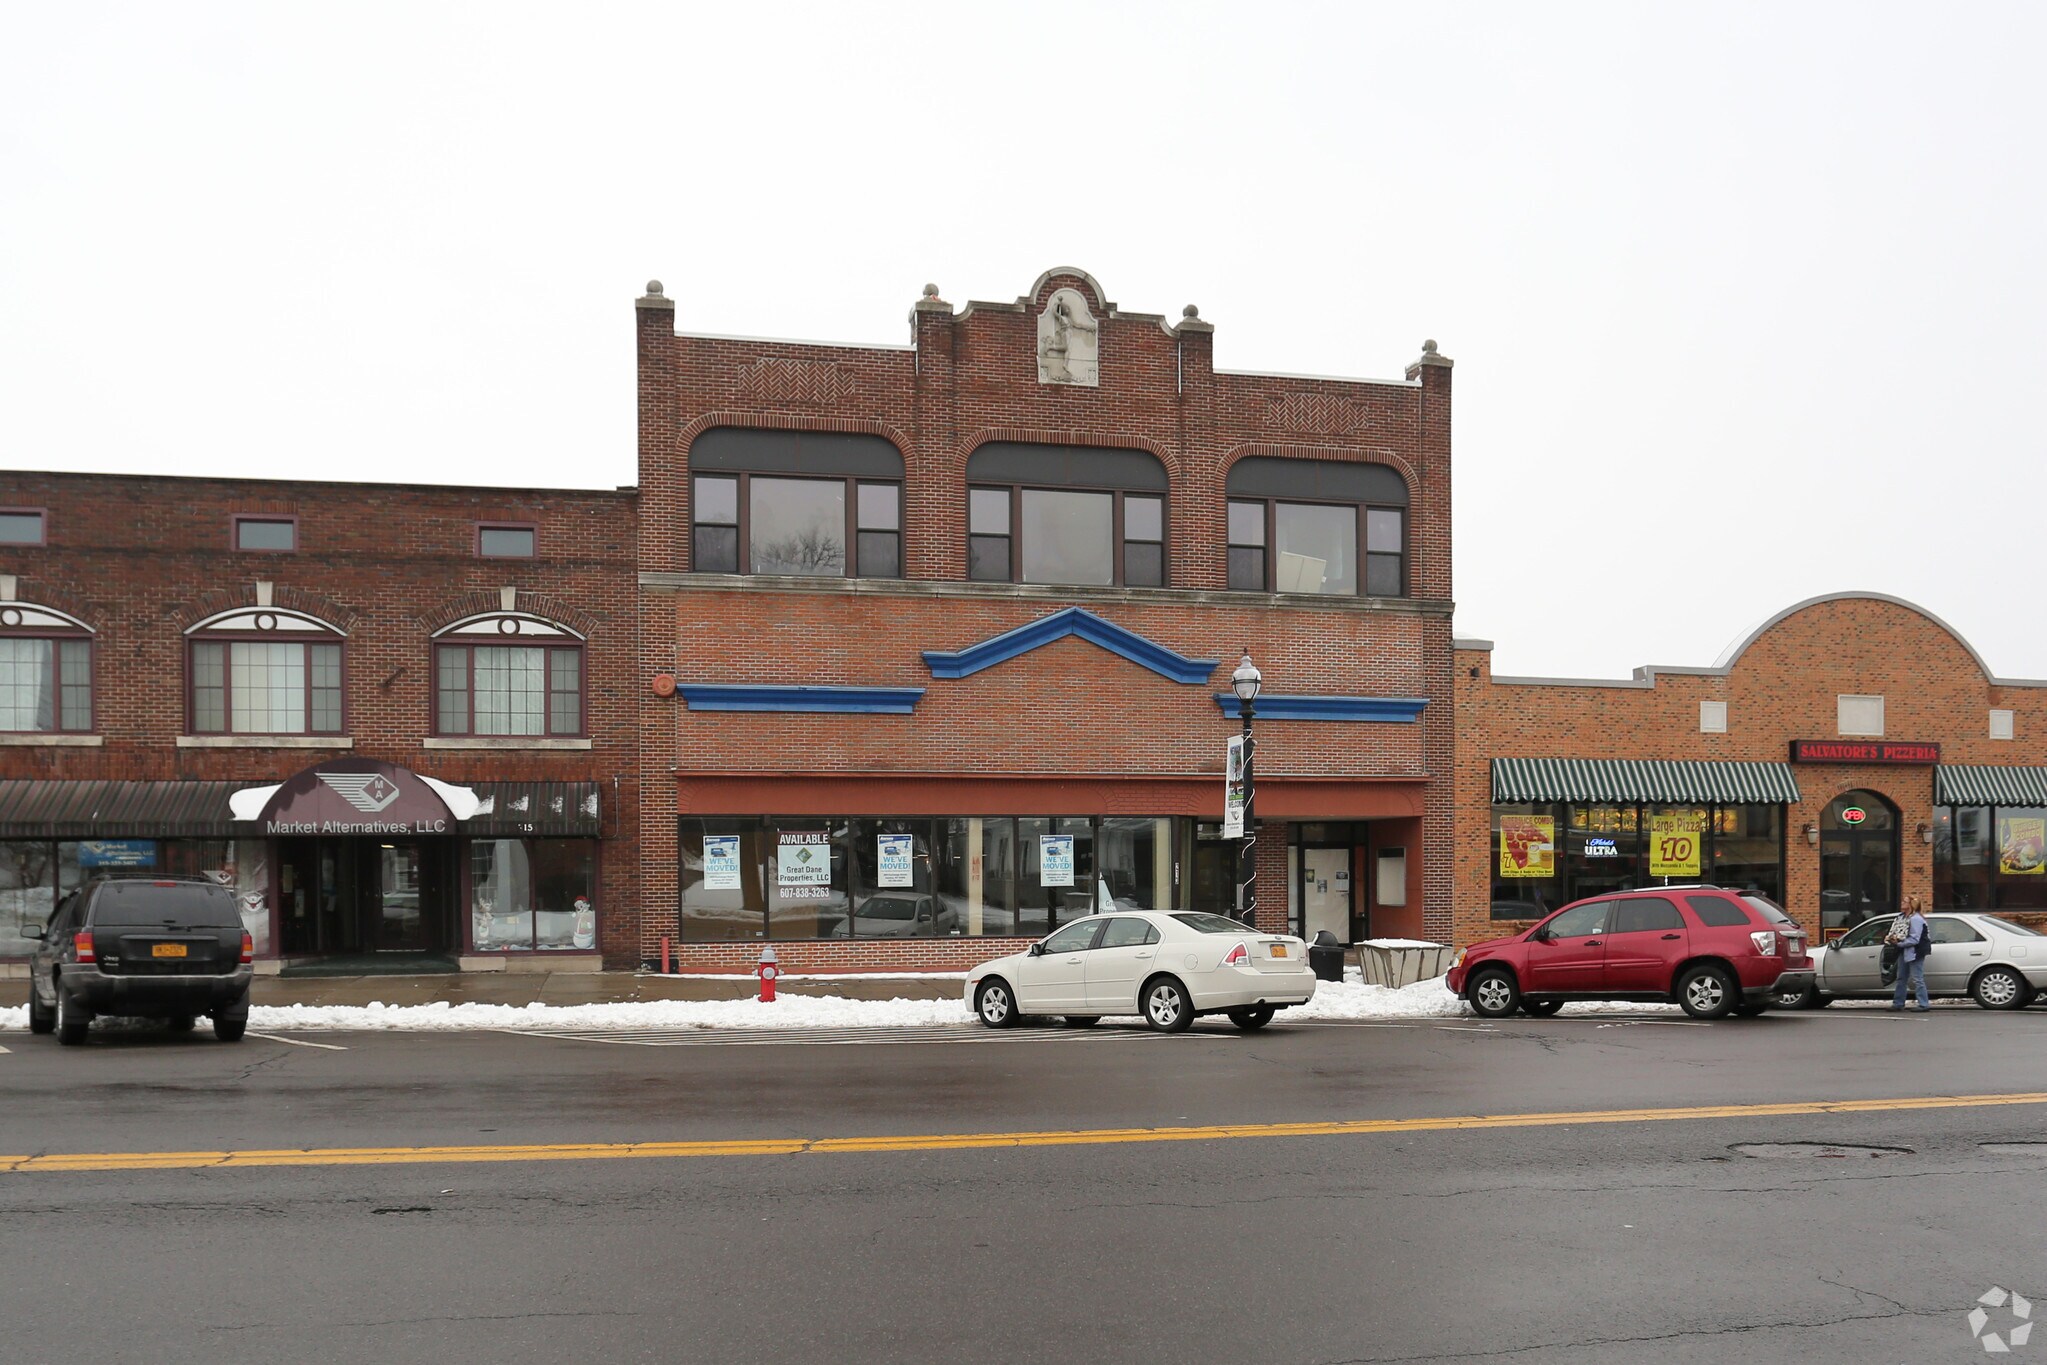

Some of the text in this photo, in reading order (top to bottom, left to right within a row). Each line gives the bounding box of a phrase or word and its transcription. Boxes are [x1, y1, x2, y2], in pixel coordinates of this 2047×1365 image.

[1801, 745, 1937, 759] SALVATORE'S PIZZERIA
[375, 780, 384, 789] M
[375, 790, 384, 799] A
[1534, 816, 1553, 825] COMBO
[267, 820, 446, 835] Market Alternatives, LLC
[518, 823, 533, 832] 15
[1651, 818, 1700, 835] Large Pizza
[780, 834, 829, 845] AVAILABLE
[1584, 845, 1618, 856] ULTRA
[780, 873, 829, 883] Properties, LLC
[780, 887, 829, 898] 607-838-3263
